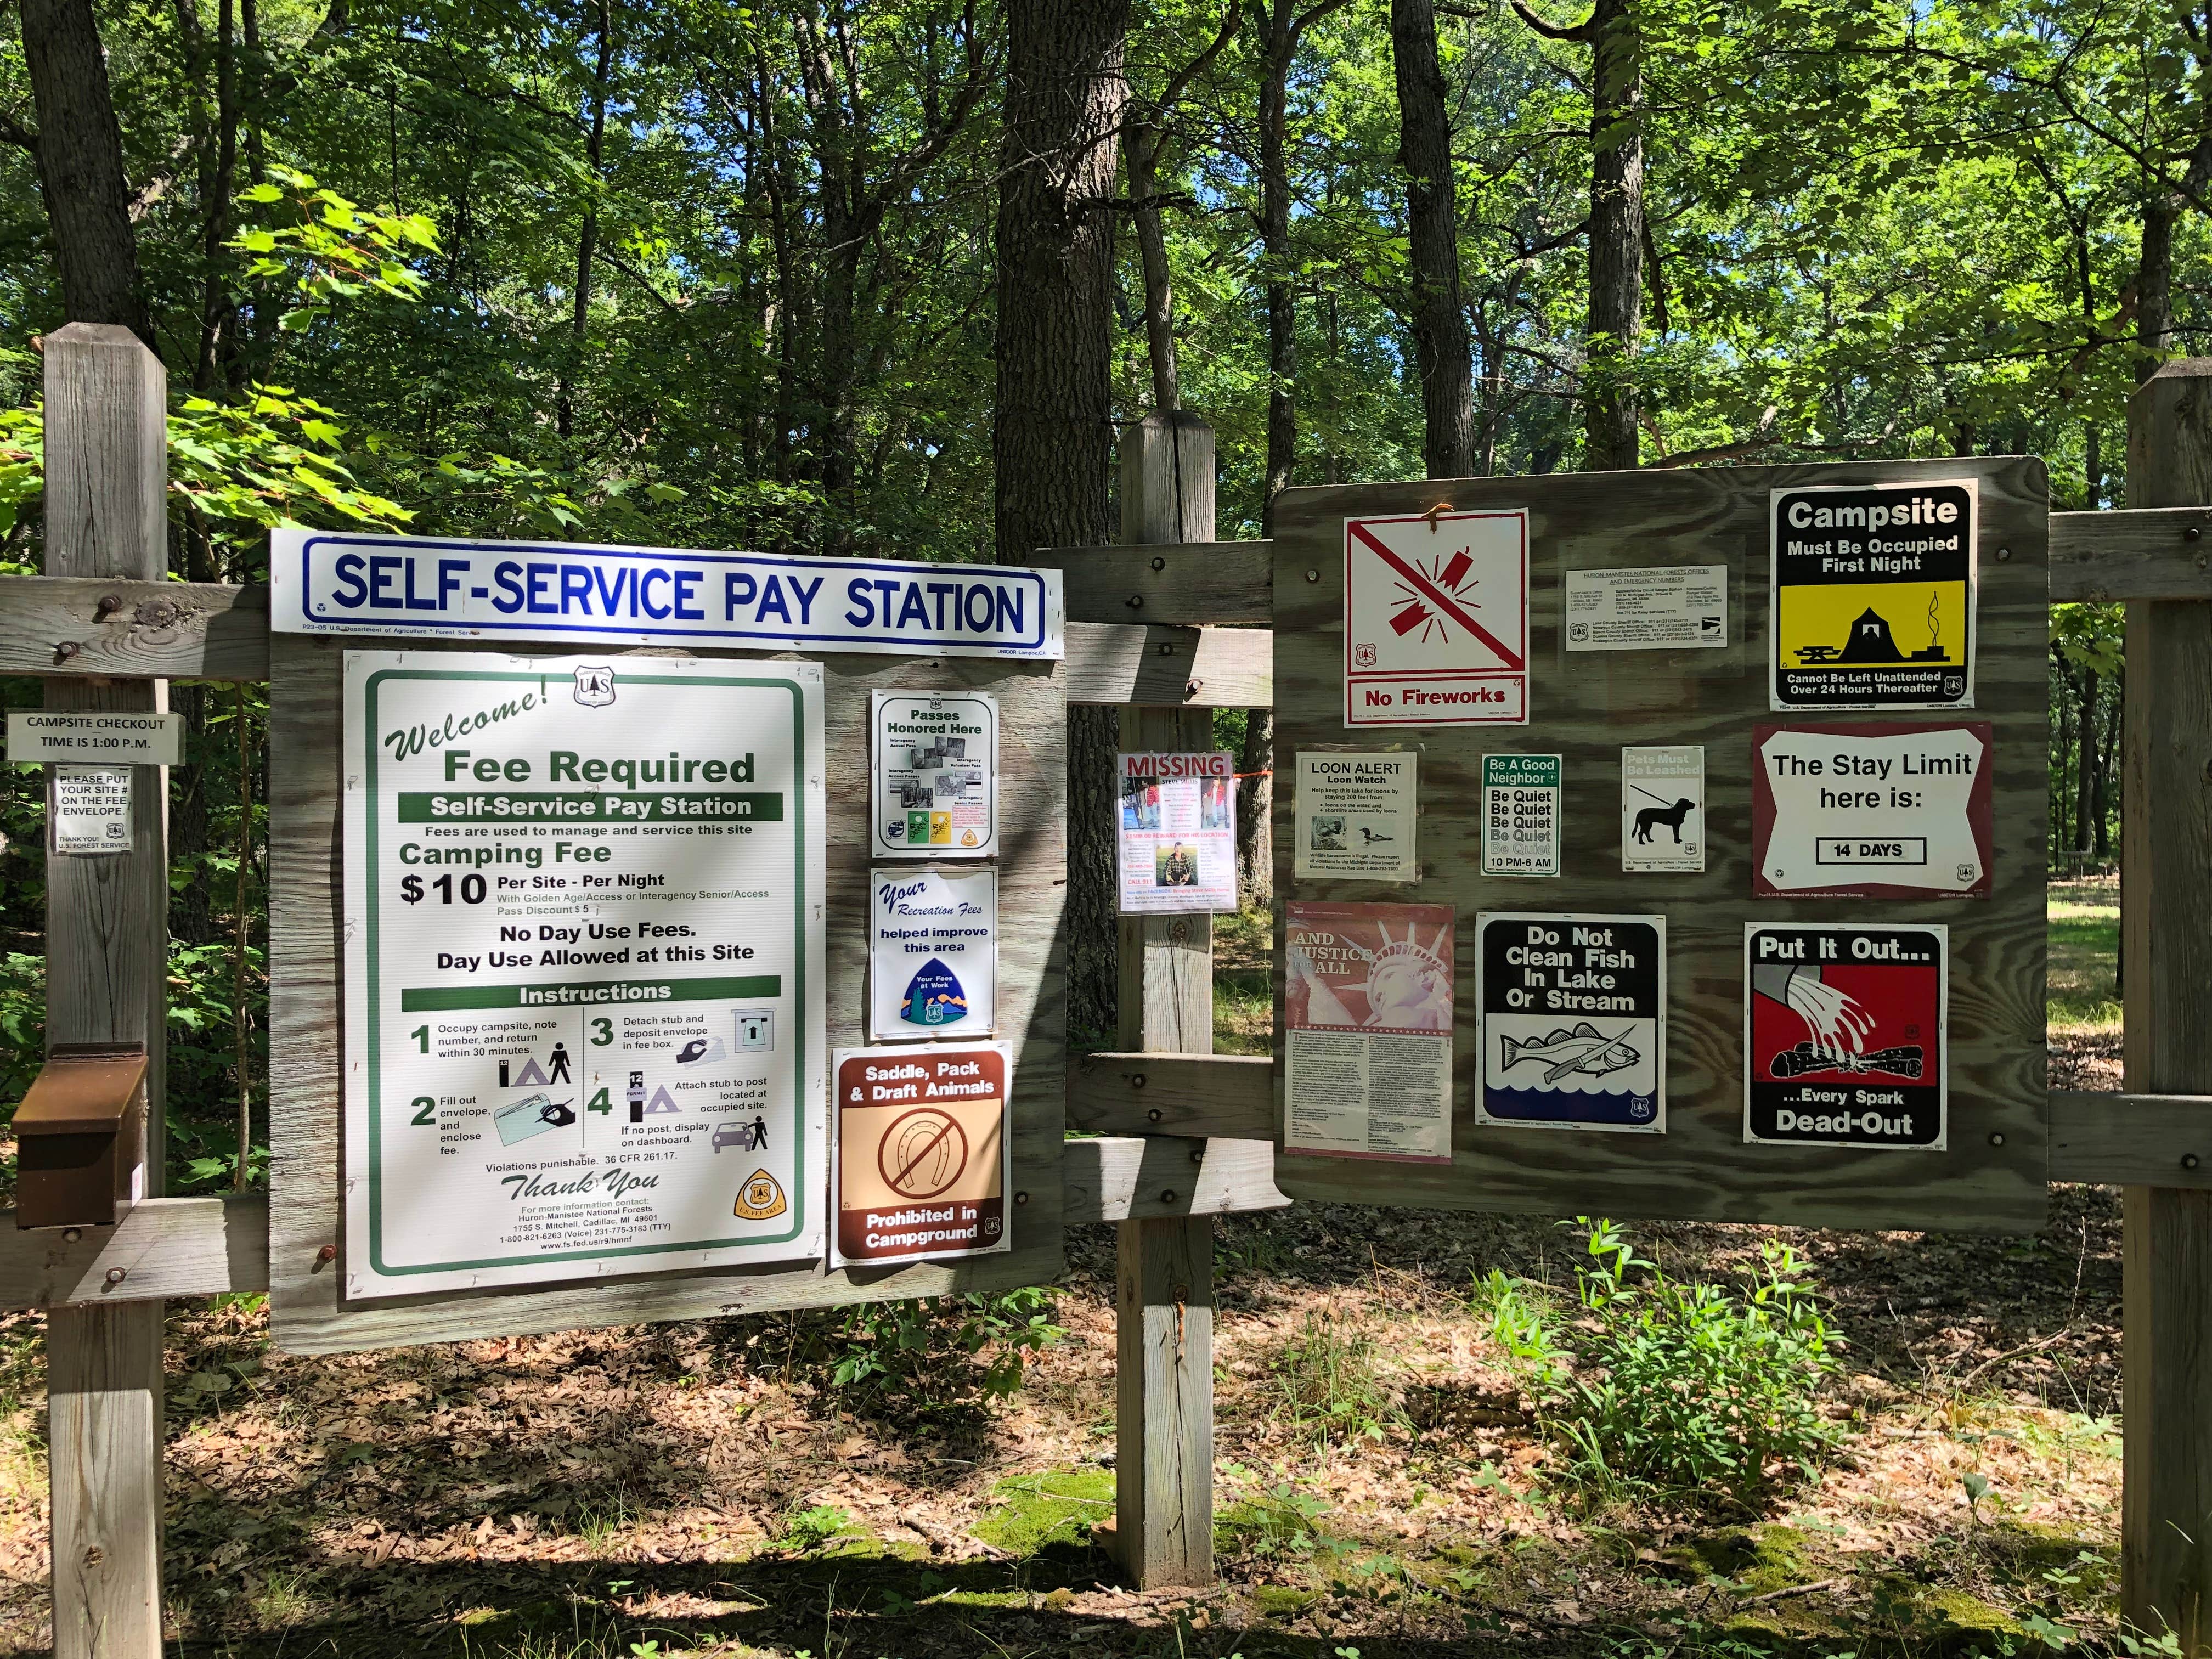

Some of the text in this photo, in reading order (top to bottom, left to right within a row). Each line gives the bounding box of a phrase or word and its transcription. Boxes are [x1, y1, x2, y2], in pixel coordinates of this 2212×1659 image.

[1788, 497, 1957, 532] Campsite
[1788, 535, 1957, 555] Must Be Occupied
[1823, 556, 1920, 573] First Night
[331, 554, 1023, 633] SELF-SERVICE PAY STATION
[1787, 672, 1940, 683] Cannot Be Left Unattended
[1366, 687, 1505, 706] No Fireworks
[1791, 684, 1938, 694] Over 24 Hours Thereafter
[27, 717, 165, 729] CAMPSITE CHECKOUT
[385, 674, 549, 761] Welcome!
[911, 710, 959, 720] Passes
[888, 723, 981, 734] Honored Here
[41, 737, 150, 748] TIME IS 1:00 P.M.
[1128, 756, 1223, 776] MISSING
[1490, 759, 1554, 770] Be A Good
[1628, 754, 1689, 764] Pets Must
[1773, 753, 1971, 780] The Stay Limit
[445, 751, 754, 790] Fee Required
[1312, 763, 1401, 774] LOON ALERT
[1627, 765, 1700, 775] Be Leashed
[107, 775, 129, 783] PUT
[1490, 772, 1545, 785] Neighbor
[1492, 790, 1551, 802] Be Quiet
[1821, 787, 1921, 808] here is:
[430, 795, 754, 820] Self-Service Pay Station
[1491, 803, 1550, 815] Be Quiet
[1491, 816, 1550, 829] Be Quiet
[400, 842, 611, 869] Camping Fee
[1834, 844, 1902, 856] 14 DAYS
[1506, 858, 1531, 866] PM-6
[1536, 859, 1550, 867] AM
[879, 882, 927, 915] Your
[898, 903, 982, 916] Recreation Fees
[501, 922, 696, 944] No Day Use Fees.
[881, 928, 988, 939] helped improve
[1294, 933, 1334, 945] AND
[1528, 926, 1612, 946] Do Not
[904, 944, 930, 952] this
[1294, 946, 1373, 961] JUSTICE
[1760, 937, 1929, 960] Put It Out...
[1506, 947, 1634, 968] Clean Fish
[1314, 962, 1350, 974] ALL
[1525, 968, 1615, 989] In Lake
[520, 985, 672, 1004] Instructions
[1506, 989, 1634, 1011] Or Stream
[866, 1062, 979, 1080] Saddle, Pack
[850, 1080, 993, 1101] & Draft Animals
[1784, 1088, 1904, 1106] ...Every Spark
[1777, 1110, 1912, 1135] Dead-Out
[518, 1211, 584, 1222] Huron-Manistee
[586, 1208, 620, 1216] National
[546, 1220, 580, 1229] Mitchell,
[583, 1217, 618, 1227] Cadillac,
[866, 1207, 976, 1228] Prohibited in
[866, 1226, 977, 1248] Campground
